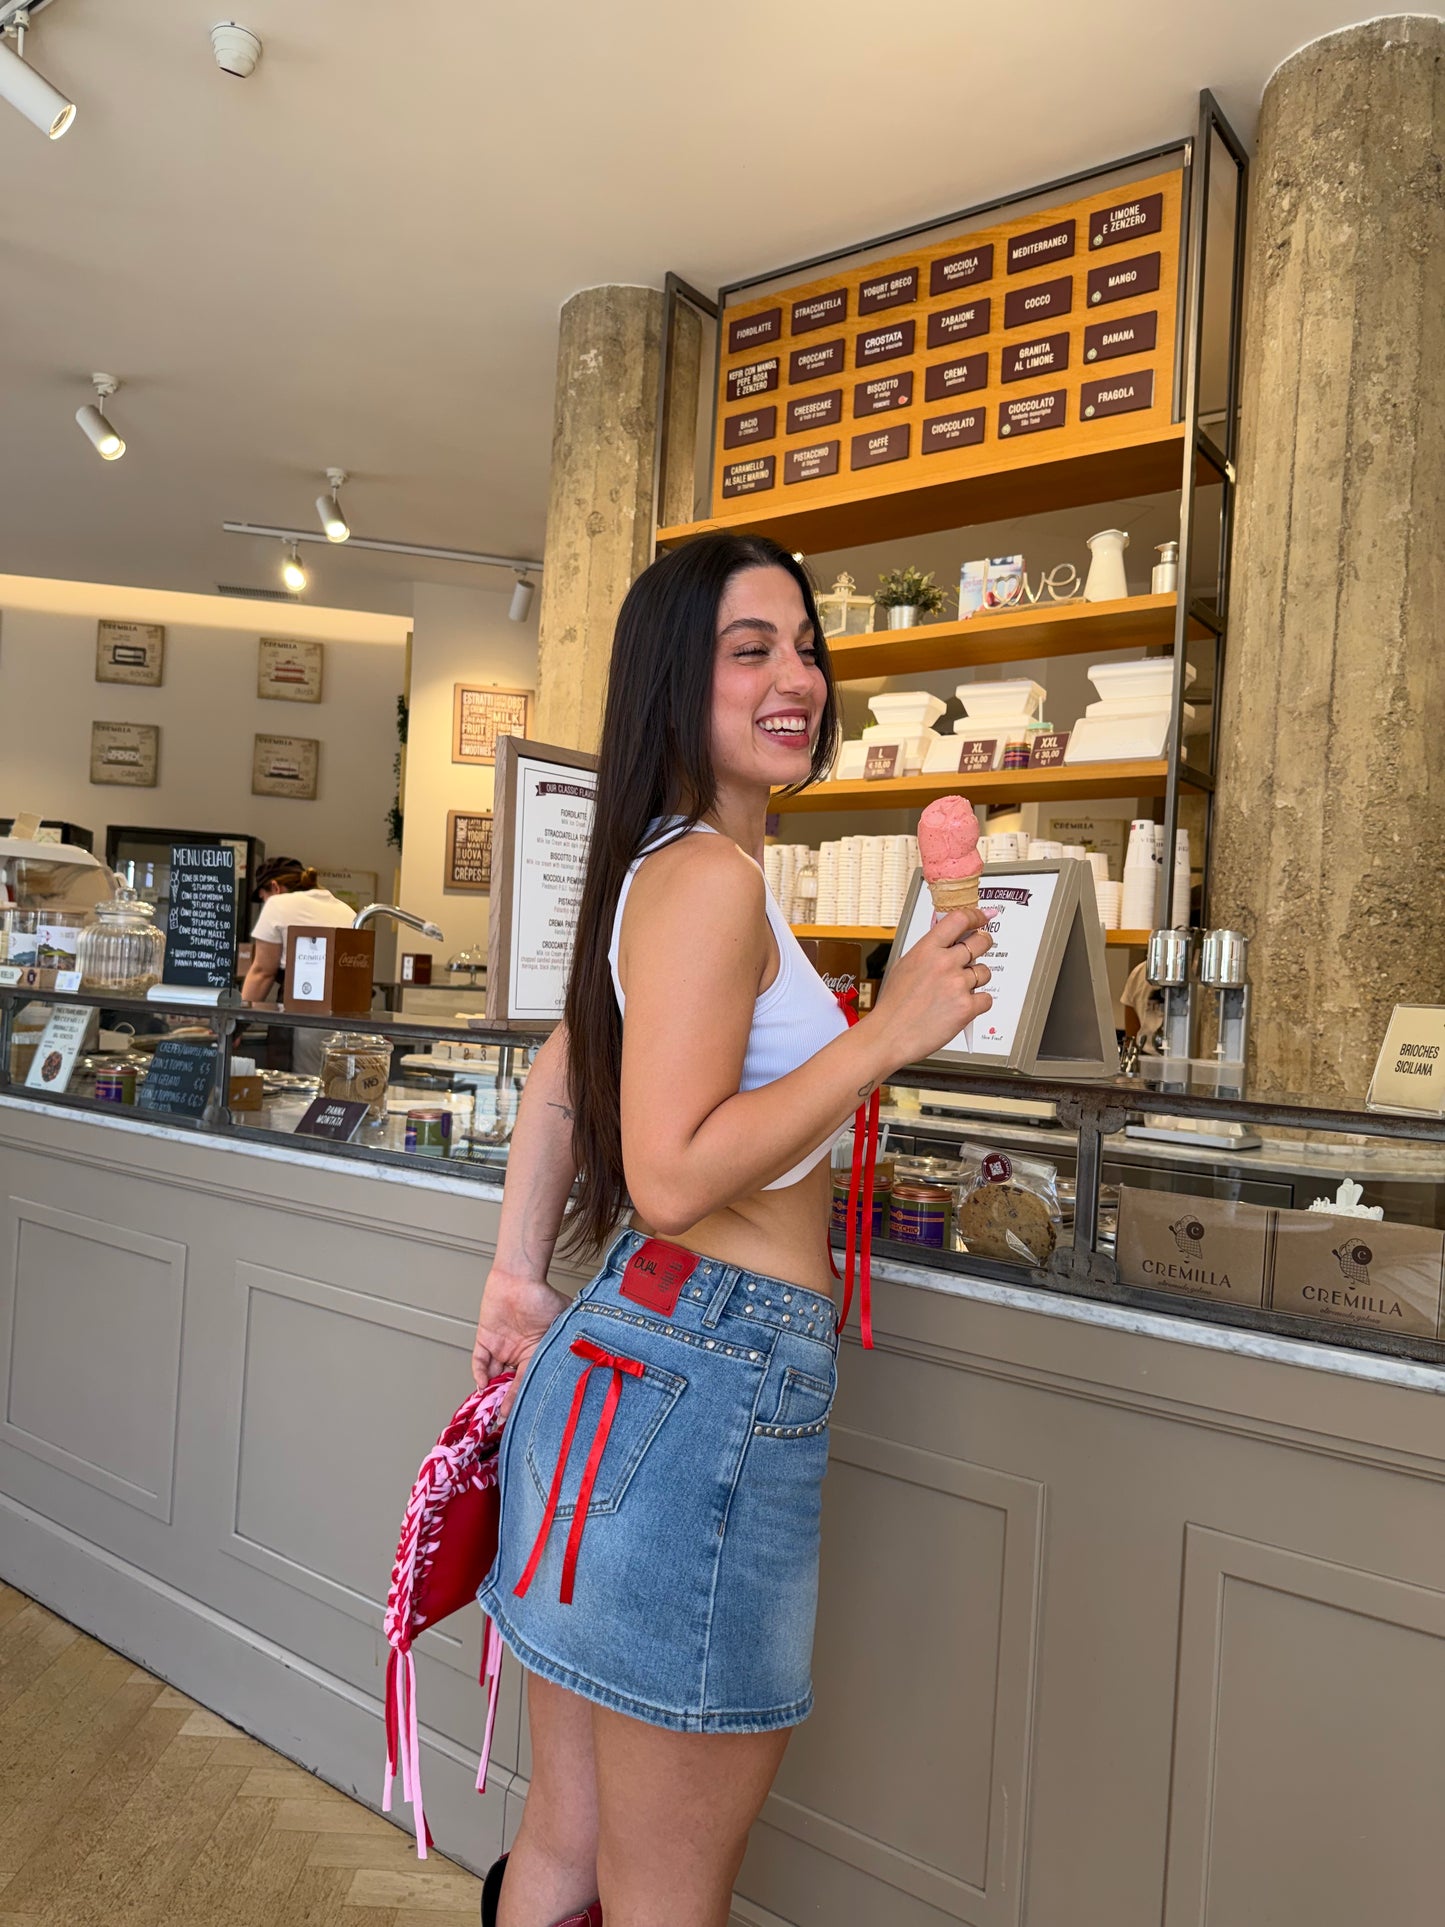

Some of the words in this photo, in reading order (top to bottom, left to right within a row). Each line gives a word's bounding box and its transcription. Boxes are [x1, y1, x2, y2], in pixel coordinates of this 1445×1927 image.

[1110, 204, 1140, 222] LIMONE
[1103, 224, 1108, 234] E
[1110, 214, 1146, 232] ZENZERO
[1012, 234, 1068, 258] MEDITERRANEO
[943, 257, 978, 275] NOCCIOLA
[1109, 271, 1137, 287] MANGO
[863, 283, 888, 298] YOGURT
[890, 276, 912, 290] GRECO
[795, 297, 841, 318] STRACCIATELLA
[1025, 294, 1051, 310] COCCO
[941, 310, 975, 327] ZABAIONE
[737, 322, 771, 340] FIORDILATTE
[1102, 329, 1134, 345] BANANA
[865, 331, 903, 349] CROSTATA
[798, 348, 834, 366] CROCCANTE
[1019, 343, 1050, 359] GRANITA
[1014, 361, 1023, 371] AL
[1026, 354, 1054, 369] LIMONE
[729, 369, 743, 381] KEFIR
[744, 366, 756, 377] CON
[757, 360, 777, 374] MANGO,
[944, 366, 967, 381] CREMA
[737, 375, 751, 387] PEPE
[752, 371, 768, 383] ROSA
[867, 378, 899, 394] BISCOTTO
[736, 386, 741, 396] E
[742, 380, 768, 395] ZENZERO
[1098, 386, 1134, 403] FRAGOLA
[794, 399, 832, 416] CHEESECAKE
[1008, 397, 1055, 415] CIOCCOLATO
[740, 417, 758, 430] BACIO
[931, 417, 975, 435] CIOCCOLATO
[868, 435, 889, 449] CAFFÈ
[793, 446, 829, 463] PISTACCHIO
[731, 460, 764, 475] CARAMELLO
[724, 477, 732, 487] AL
[732, 473, 746, 486] SALE
[747, 469, 769, 483] MARINO
[982, 557, 1081, 610] love
[493, 711, 519, 724] MILK
[463, 722, 486, 735] FRUIT
[971, 742, 983, 753] XL
[1040, 737, 1058, 748] XXL
[878, 748, 884, 759] L
[970, 755, 988, 764] 24,00
[1040, 750, 1060, 759] 30,00
[546, 783, 557, 793] OUR
[557, 784, 579, 796] CLASSIC
[560, 808, 587, 820] FIORDILATTE
[1053, 822, 1094, 830] CREMILLA
[468, 830, 488, 843] YOGURT
[544, 828, 579, 841] STRACCIATELLA
[173, 848, 201, 867] MENU
[201, 850, 233, 868] GELATO
[461, 849, 482, 860] UOVA
[550, 852, 572, 861] BISCOTTO
[181, 873, 193, 883] CONE
[207, 875, 219, 883] SMALL
[454, 866, 482, 882] CRÊPES
[543, 873, 565, 883] NOCCIOLA
[181, 891, 193, 900] CONE
[206, 893, 224, 901] MEDIUM
[197, 884, 215, 893] FLAVORS
[986, 890, 993, 900] DI
[994, 890, 1024, 901] CREMILLA
[180, 908, 192, 917] CONE
[207, 911, 216, 919] BIG
[196, 902, 215, 910] FLAVORS
[178, 926, 191, 935] CONE
[196, 919, 215, 928] FLAVORS
[549, 919, 564, 927] CREMA
[195, 937, 215, 947] FLAVORS
[542, 940, 568, 950] CROCCANTE
[175, 949, 197, 958] WHIPPED
[338, 952, 369, 968] Coca-Cola
[174, 958, 193, 967] PANNA
[193, 960, 216, 969] MONTATA
[207, 972, 227, 987] Enjoy
[821, 972, 856, 993] Coca-Col
[447, 1046, 452, 1059] 1
[480, 1050, 487, 1061] 3
[1399, 1043, 1440, 1059] BRIOCHES
[169, 1058, 194, 1072] TOPPING
[1394, 1060, 1433, 1076] SICILIANA
[159, 1074, 181, 1087] GELATO
[325, 1104, 346, 1116] PANNA
[315, 1114, 344, 1126] MONTATA
[634, 1256, 658, 1275] DUAL
[1141, 1259, 1232, 1289] CREMILLA
[1302, 1285, 1403, 1318] CREMILLA
